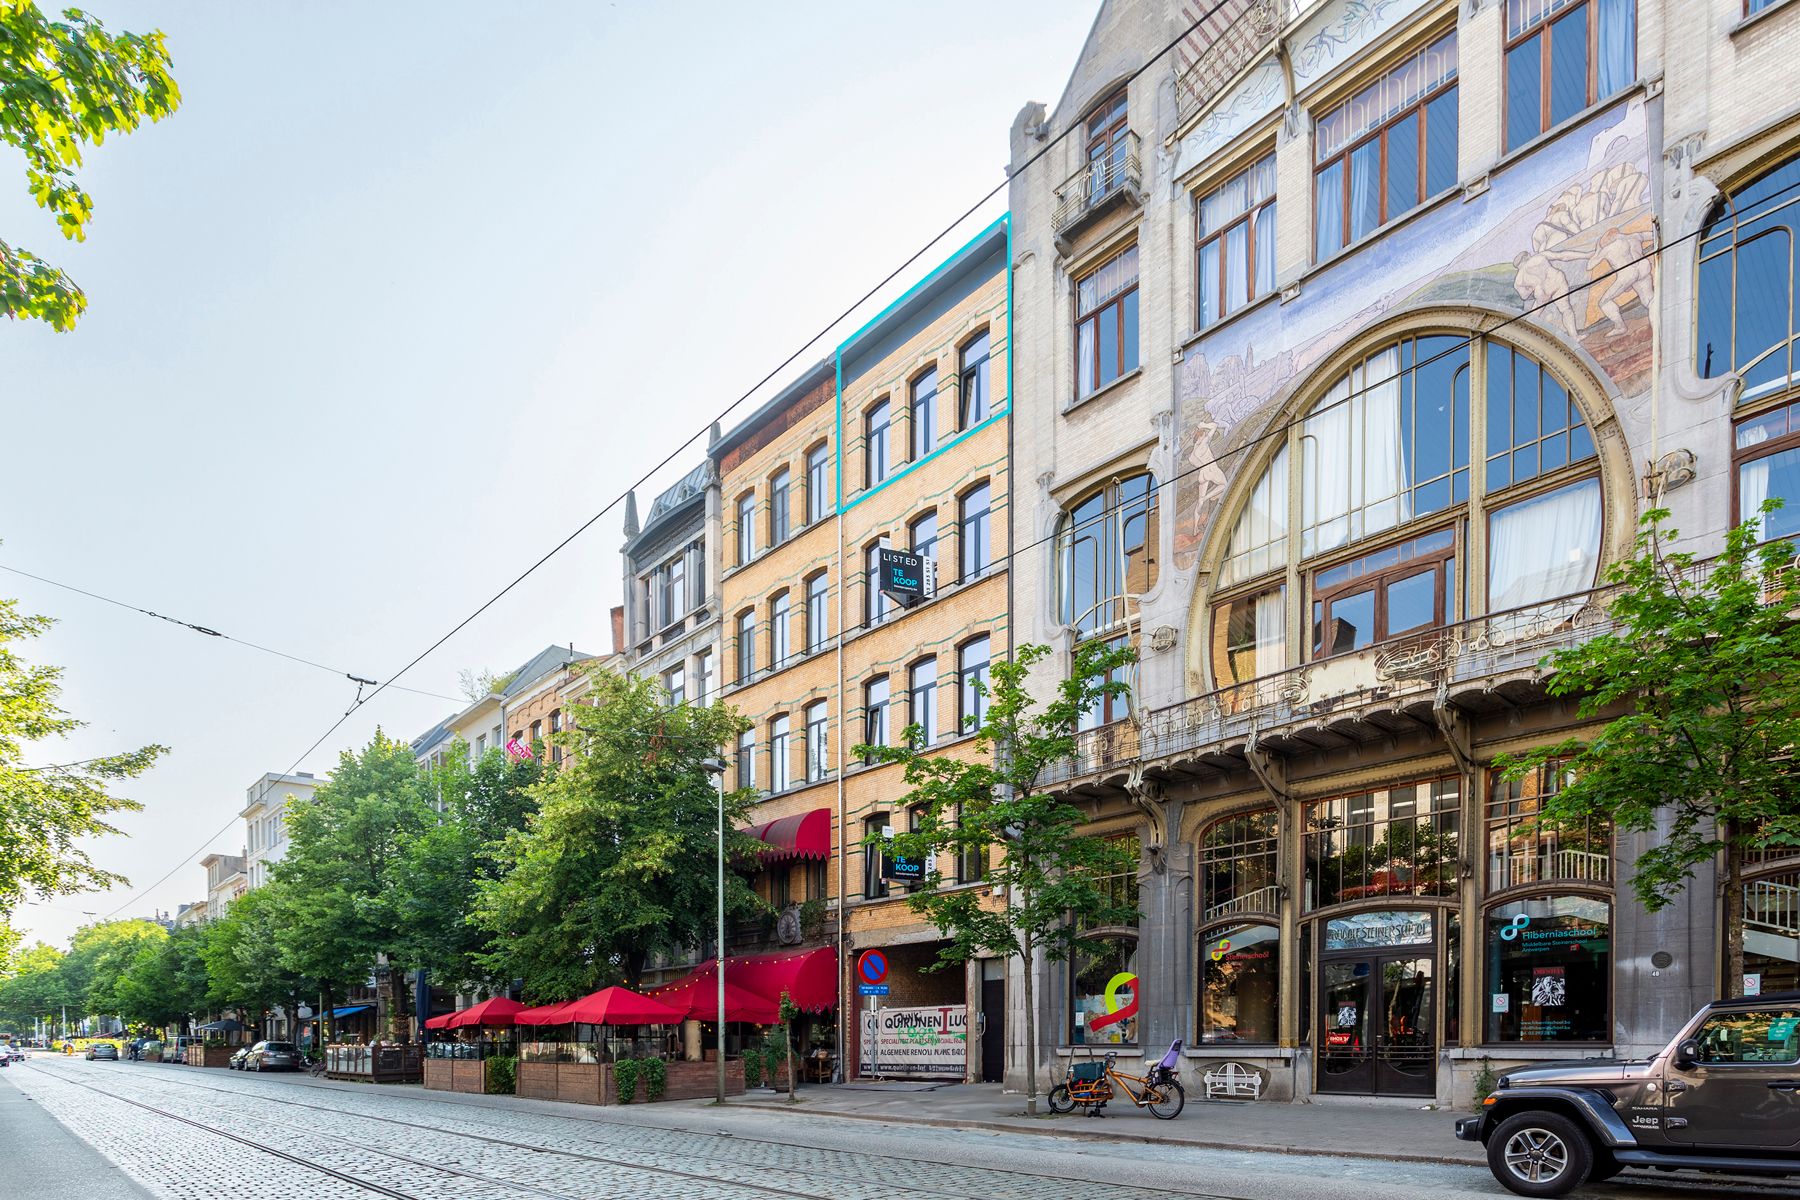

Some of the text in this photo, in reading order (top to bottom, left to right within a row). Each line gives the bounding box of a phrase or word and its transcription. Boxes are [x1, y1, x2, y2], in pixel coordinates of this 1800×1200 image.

[883, 553, 917, 566] LISTED
[893, 568, 904, 577] TE
[893, 576, 917, 586] KOOP
[895, 855, 906, 863] TE
[895, 863, 919, 871] KOOP
[1522, 927, 1597, 940] Hiberniaschool
[880, 1048, 910, 1056] ALGEMENE
[1631, 1115, 1659, 1125] Jeep
